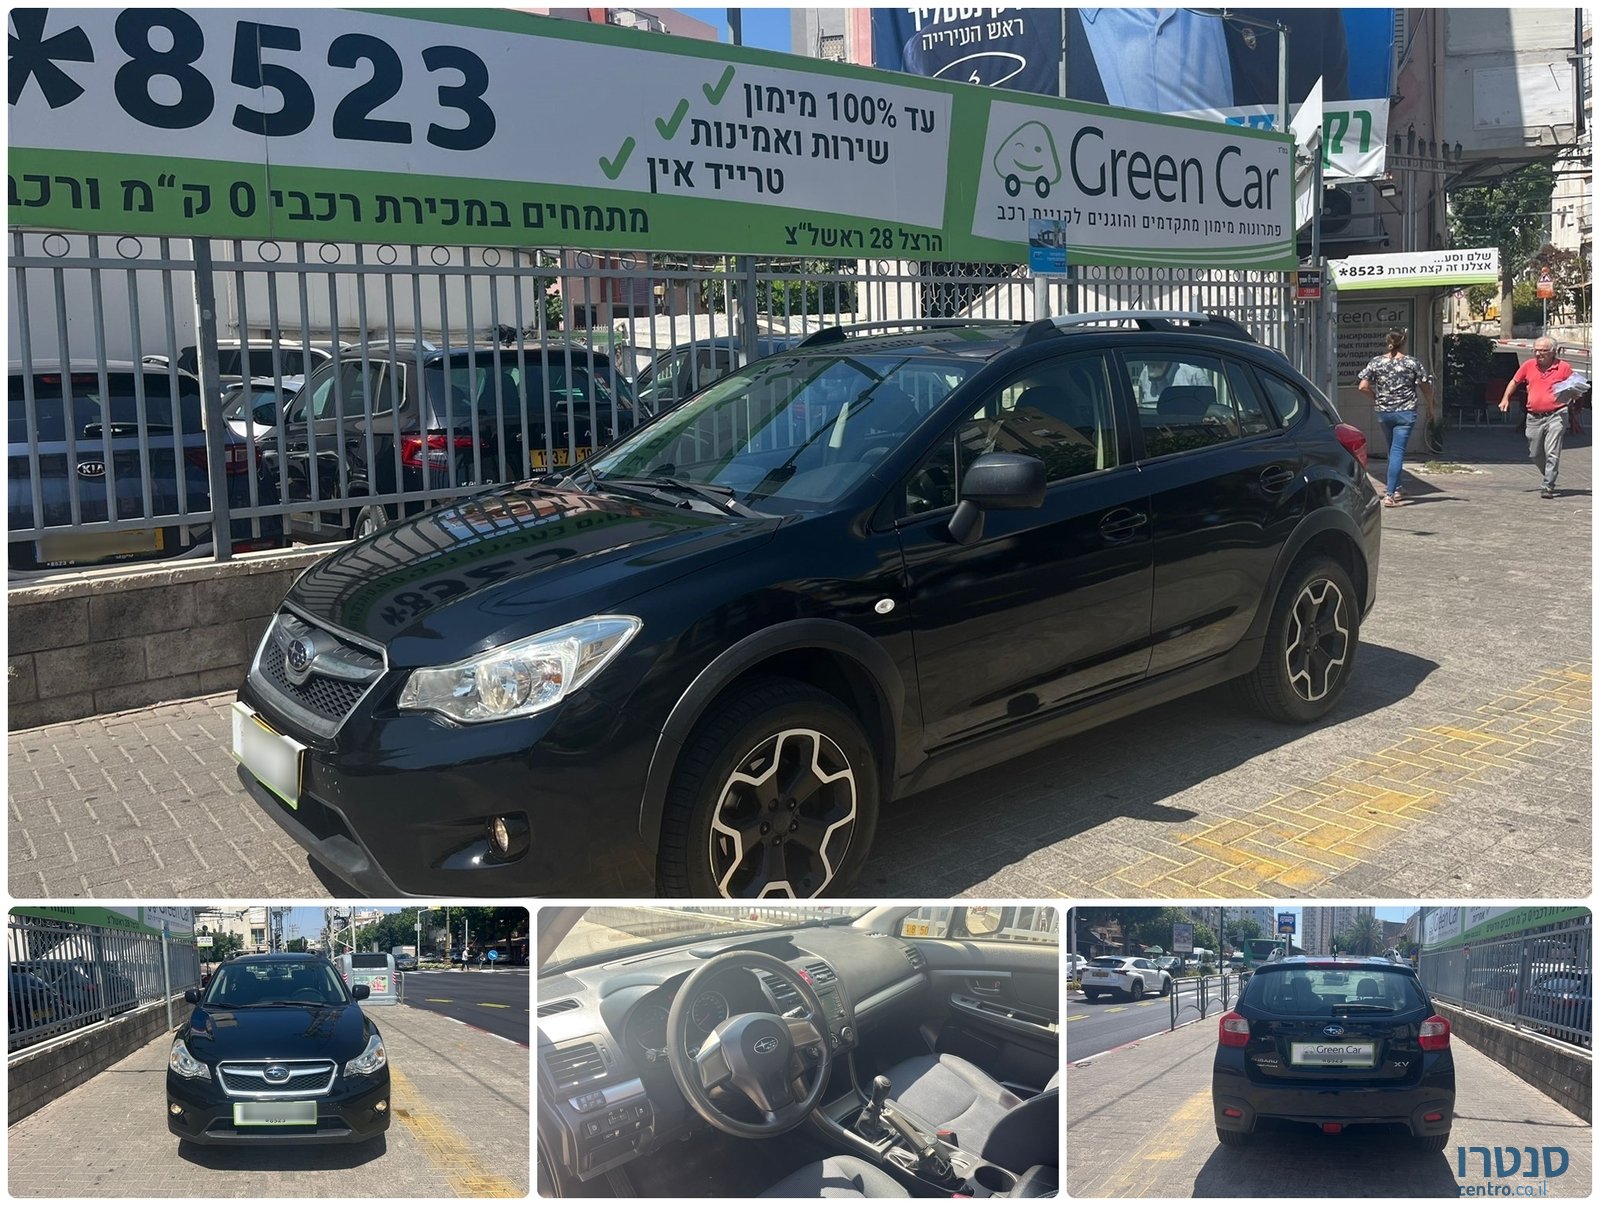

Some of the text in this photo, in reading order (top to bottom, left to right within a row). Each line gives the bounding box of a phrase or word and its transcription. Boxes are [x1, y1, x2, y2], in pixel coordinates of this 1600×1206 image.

[922, 18, 1024, 51] ראש העירייה
[743, 82, 936, 134] עד 100% מימון
[690, 118, 890, 165] שירות ואמינות
[646, 156, 785, 195] טרייד אין
[1070, 126, 1280, 211] Green Car
[229, 184, 257, 219] 0
[269, 189, 363, 224] רכבי
[374, 191, 512, 230] במכירת
[522, 201, 649, 235] מתמחים
[997, 204, 1026, 222] רכב
[1087, 212, 1137, 229] והוגנים
[1142, 215, 1200, 235] מתקדמים
[1204, 218, 1235, 237] מימון
[1238, 222, 1282, 238] פתרונות
[869, 226, 894, 250] 28
[899, 228, 944, 252] הרצל
[1461, 261, 1491, 272] אצלנו
[1467, 252, 1492, 262] שלם
[1387, 265, 1416, 276] אחרת
[1419, 263, 1442, 275] קצת
[1446, 264, 1458, 272] זה
[1376, 307, 1404, 322] Car
[82, 464, 104, 474] KIA
[1316, 1045, 1362, 1054] Green Car
